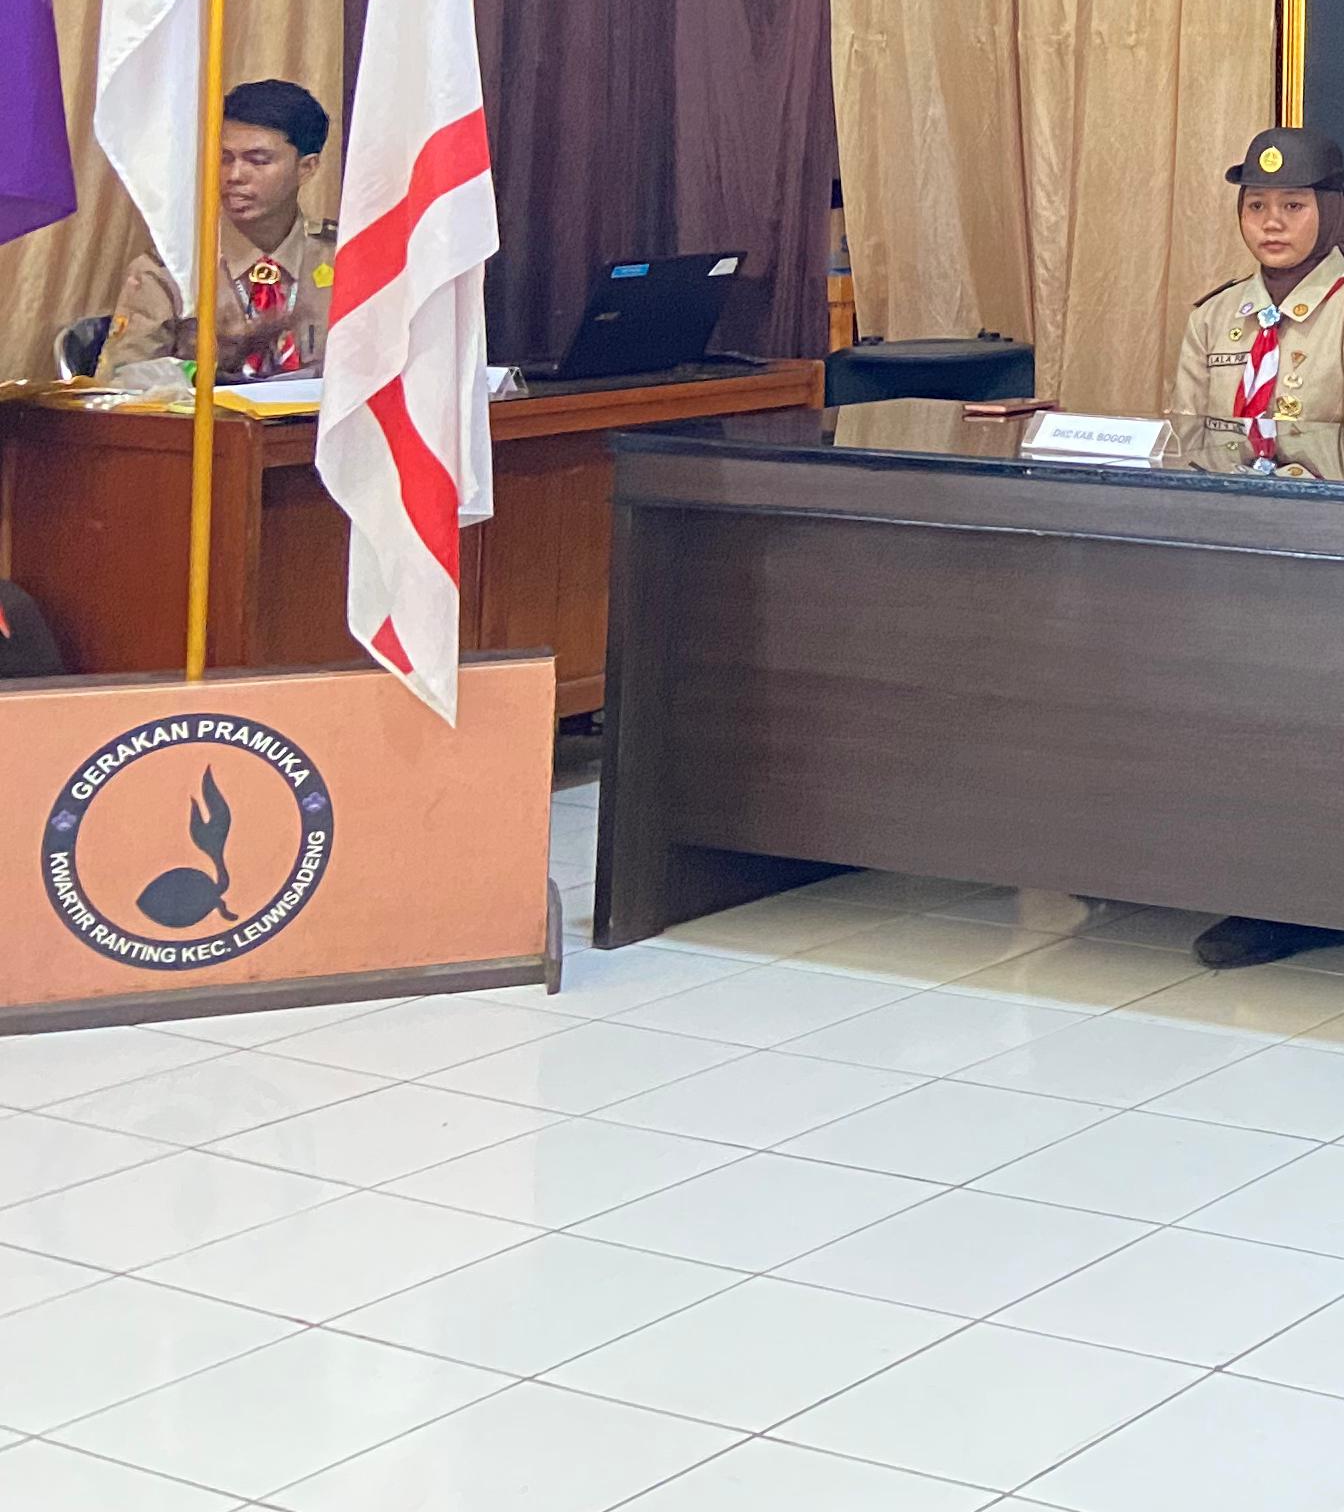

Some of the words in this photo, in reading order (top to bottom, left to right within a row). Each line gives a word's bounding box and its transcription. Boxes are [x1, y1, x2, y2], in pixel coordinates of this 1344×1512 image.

[1096, 434, 1132, 445] BOGOR
[71, 721, 190, 800] GERAKAN
[197, 720, 311, 788] PRAMUKA
[50, 851, 93, 932] KWARTIR
[89, 924, 176, 963] RANTING
[181, 940, 231, 962] KEC.
[233, 830, 326, 947] LEUWISADENG
